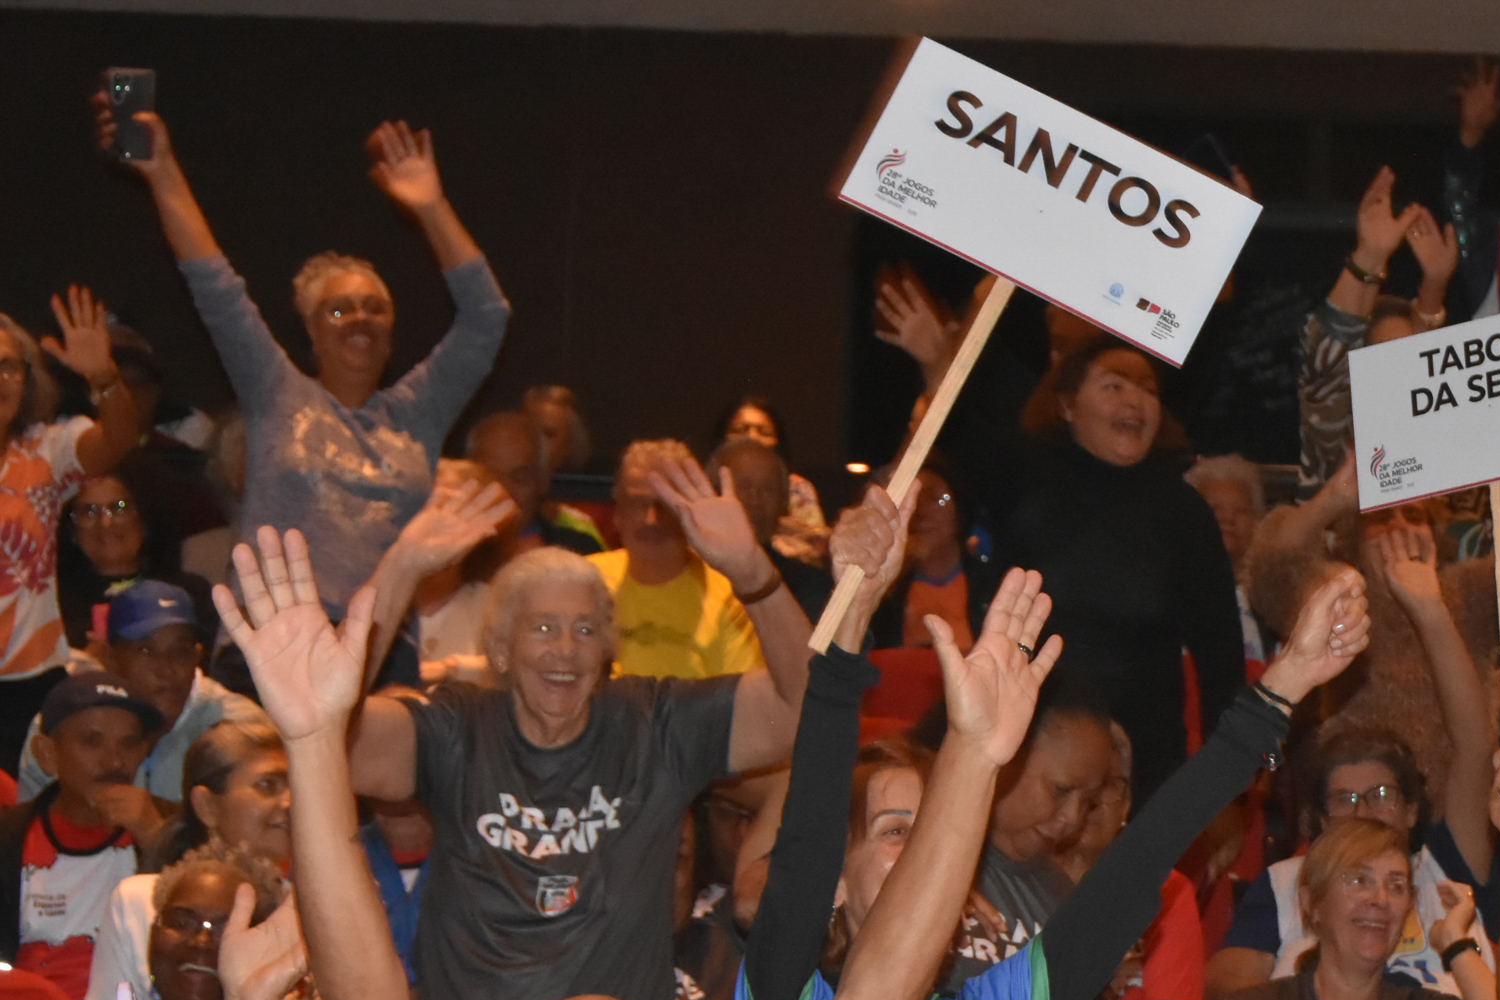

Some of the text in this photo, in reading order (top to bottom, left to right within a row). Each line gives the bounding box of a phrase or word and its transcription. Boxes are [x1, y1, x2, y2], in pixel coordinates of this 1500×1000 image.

[934, 90, 1201, 249] SANTOS
[878, 185, 906, 203] IDADE
[882, 177, 896, 189] DA
[898, 184, 938, 208] MELHOR
[903, 178, 935, 197] JOGOS
[1410, 382, 1459, 417] DA
[1392, 464, 1423, 476] MELHOR
[1393, 457, 1417, 468] JOGOS
[1380, 477, 1402, 488] IDADE
